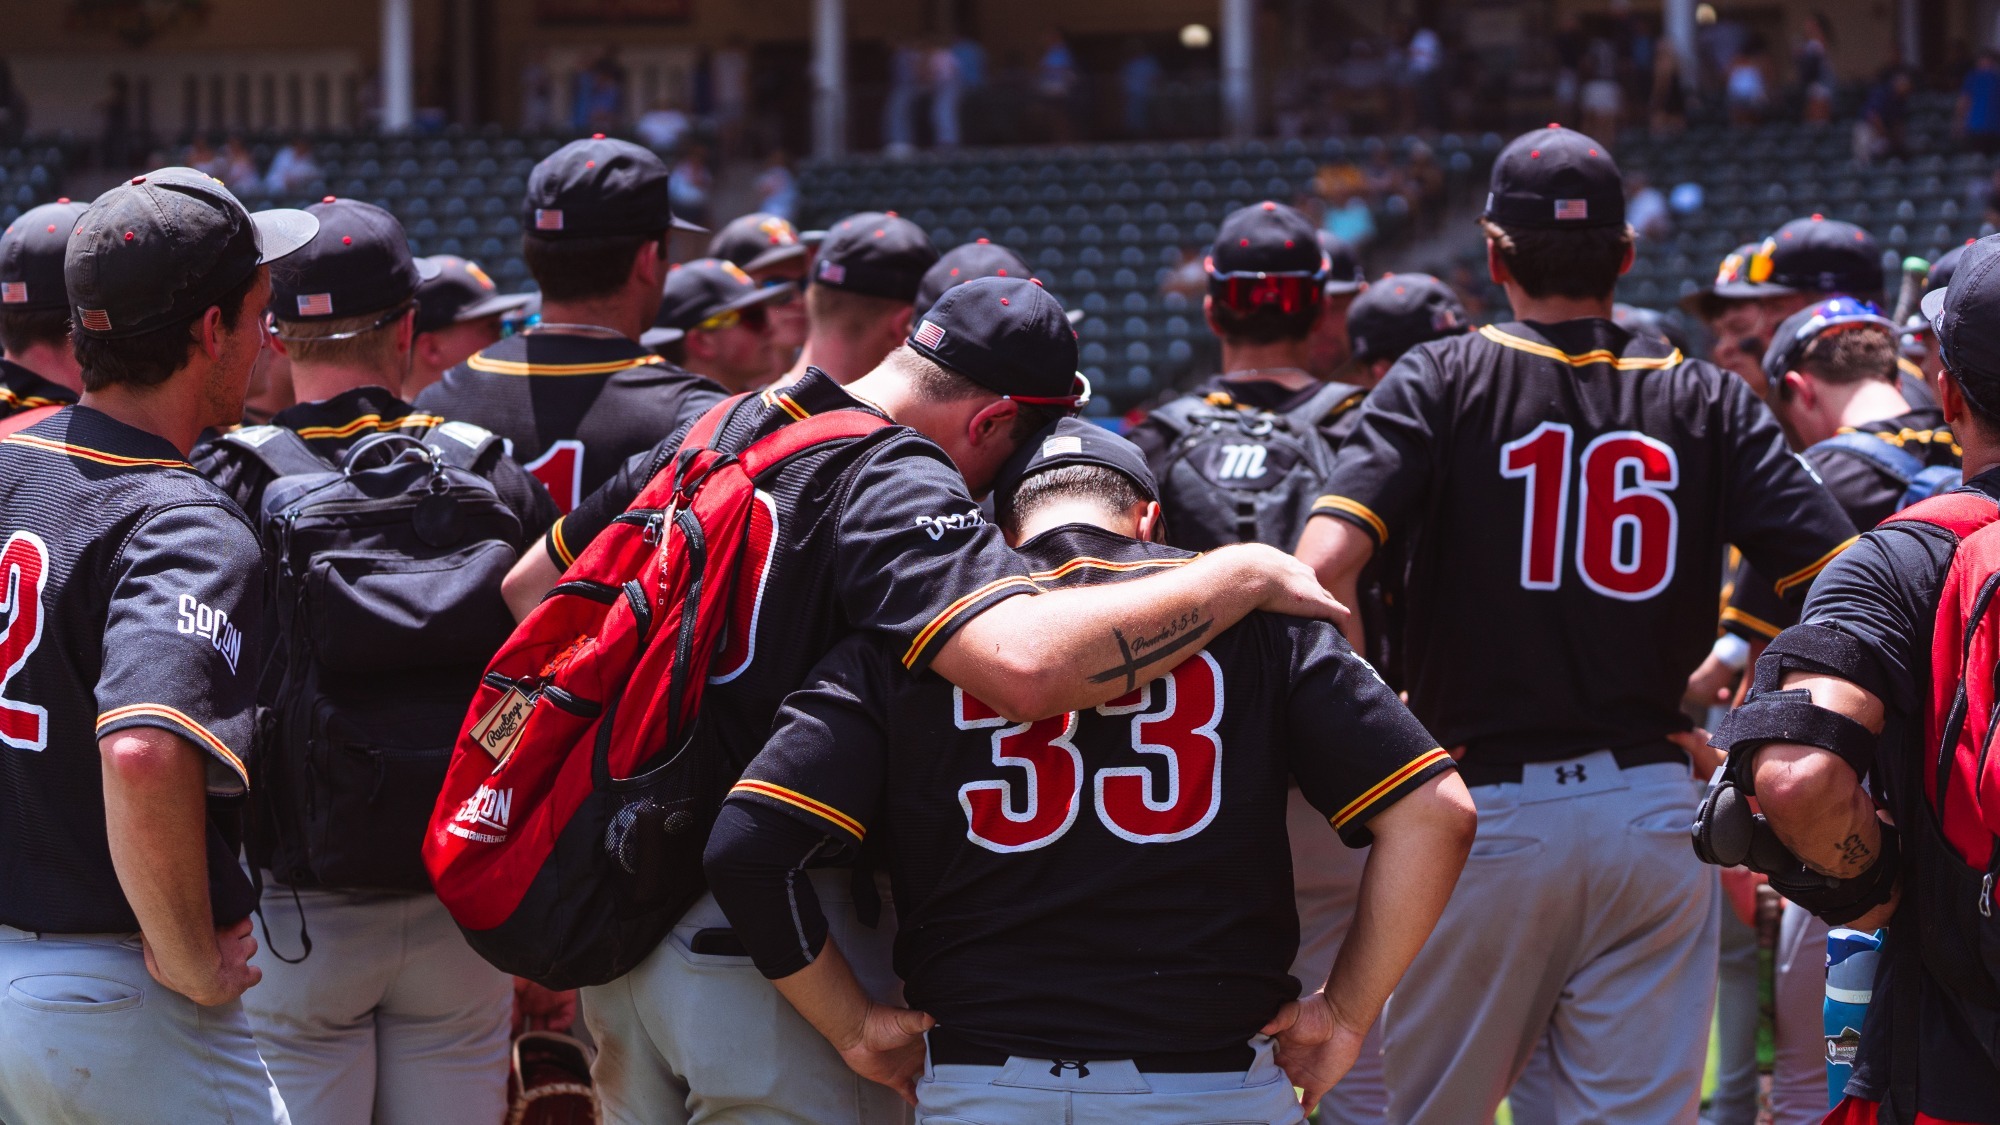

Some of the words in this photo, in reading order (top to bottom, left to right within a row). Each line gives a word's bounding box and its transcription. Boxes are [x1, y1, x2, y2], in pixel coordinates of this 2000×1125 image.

[1499, 421, 1680, 601] 16
[486, 702, 523, 748] Rawlings
[953, 649, 1225, 853] 33
